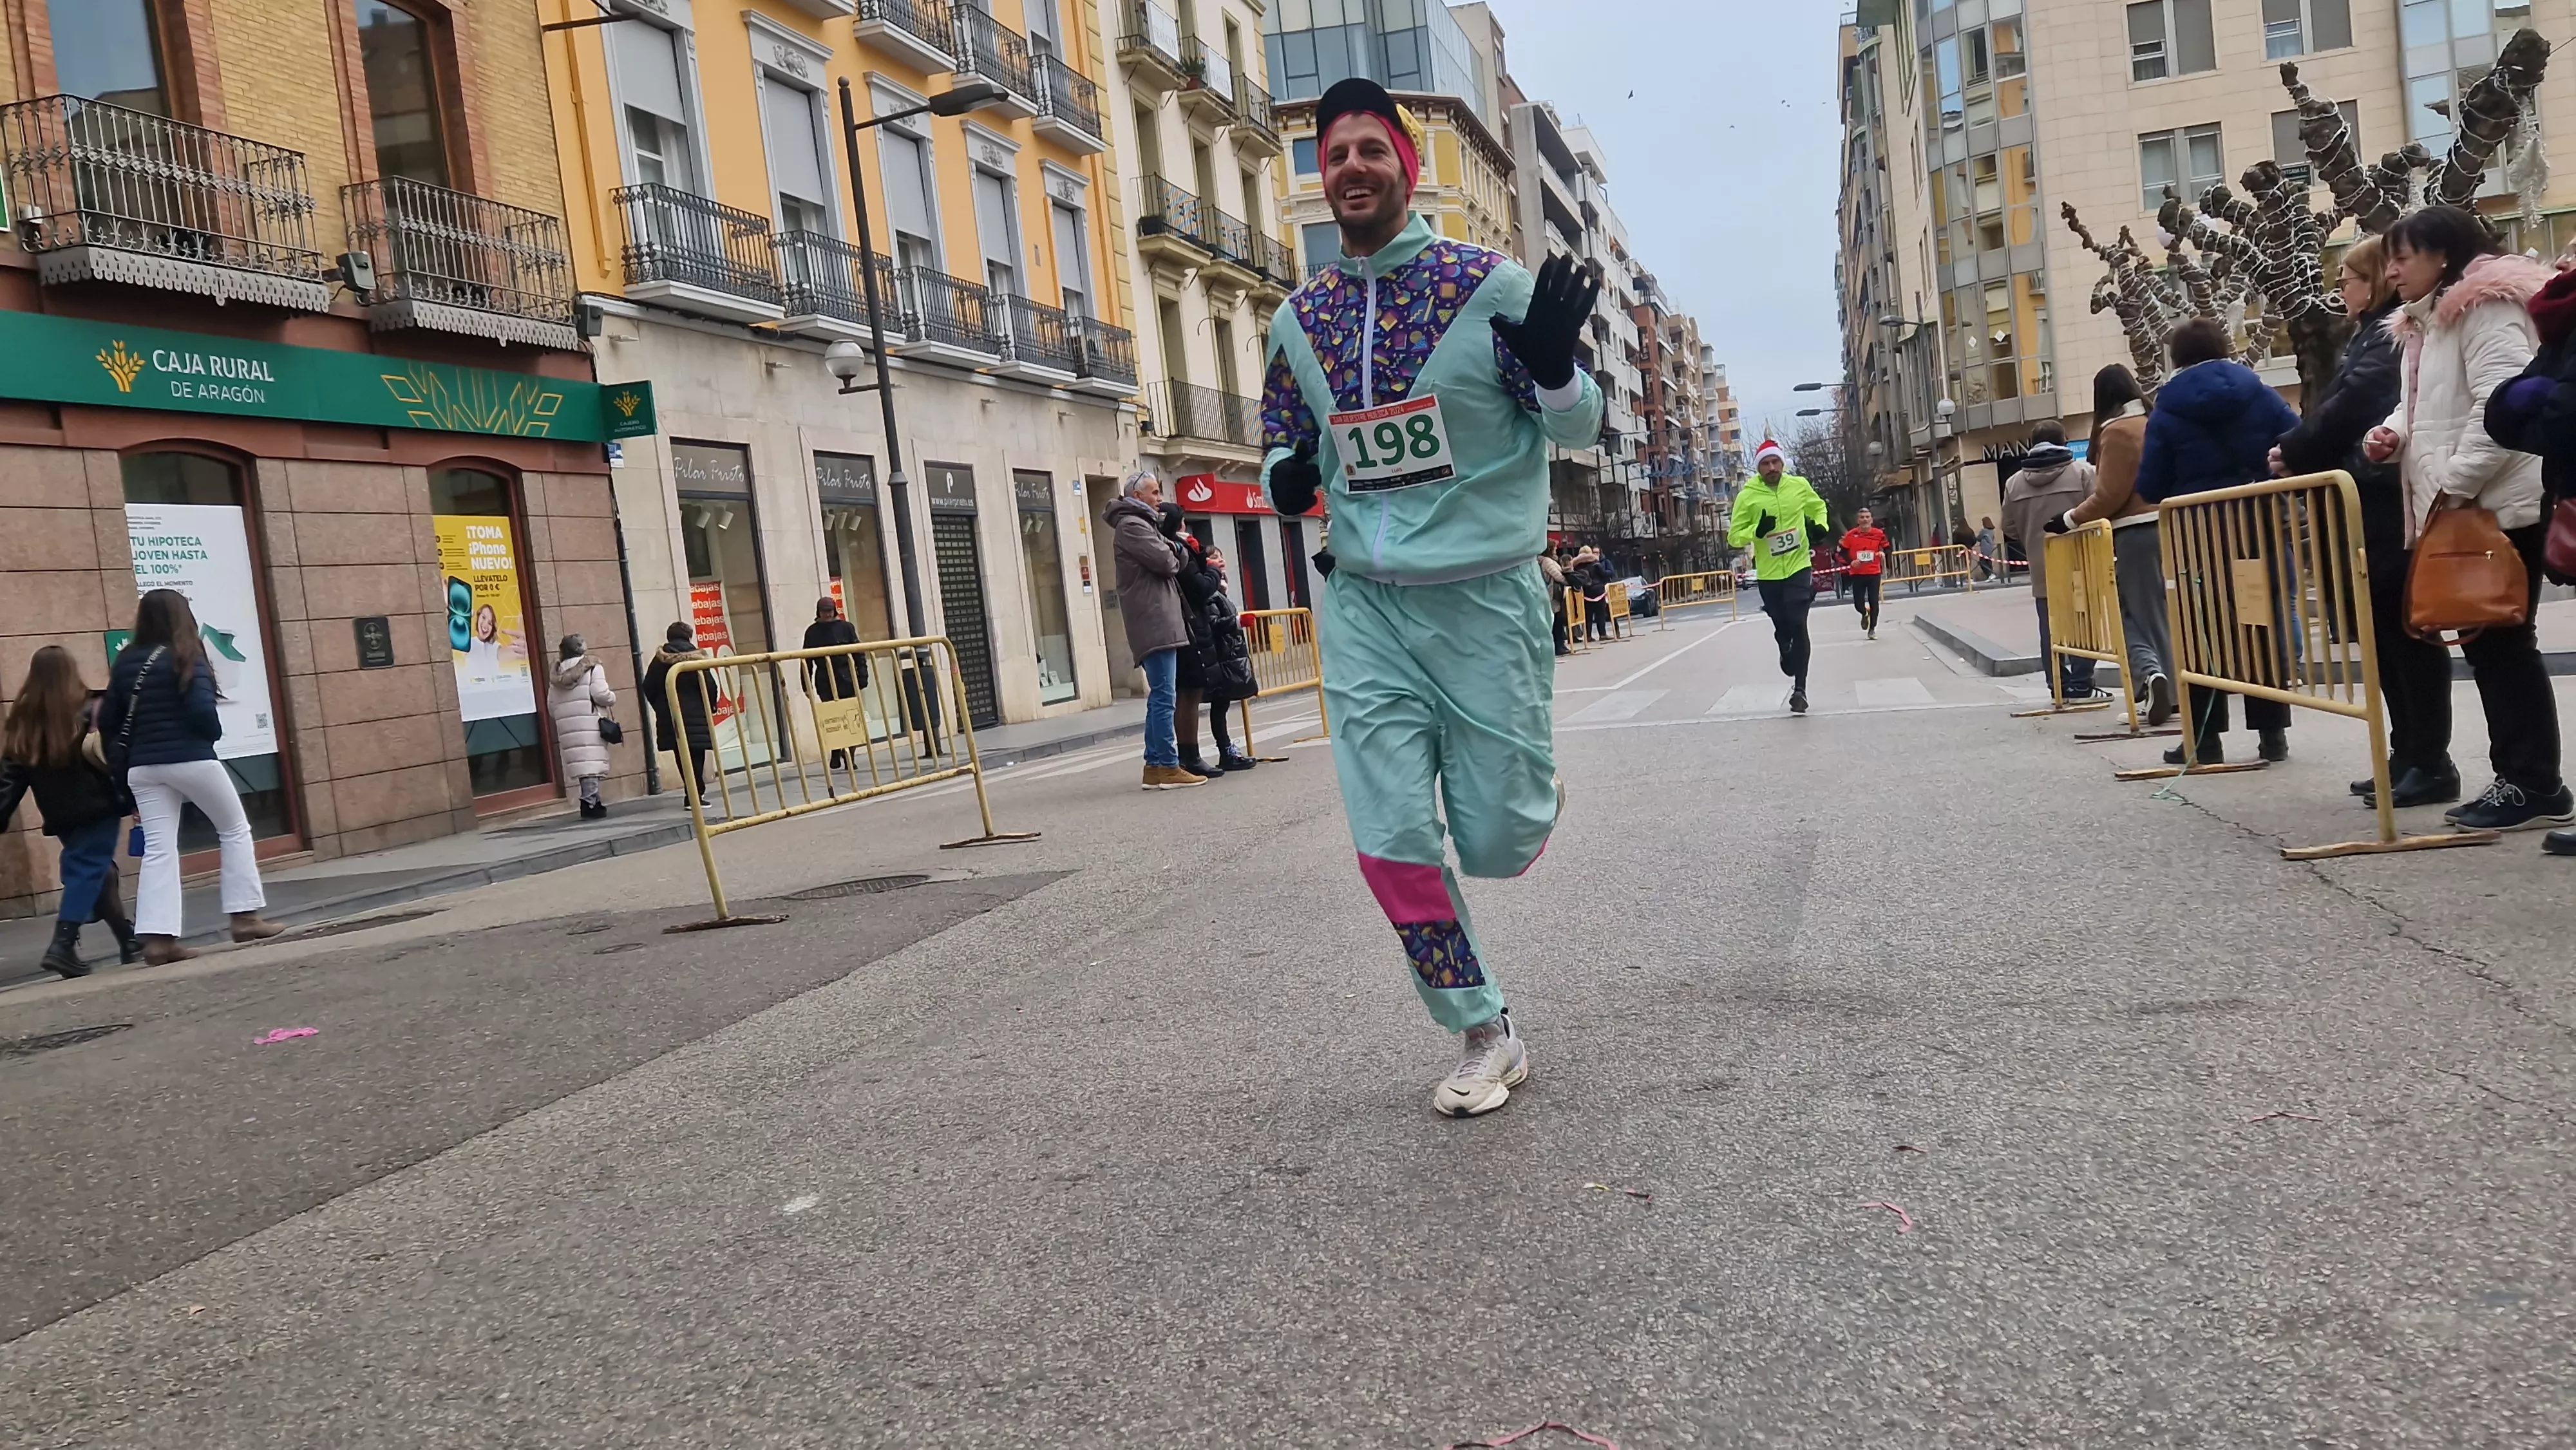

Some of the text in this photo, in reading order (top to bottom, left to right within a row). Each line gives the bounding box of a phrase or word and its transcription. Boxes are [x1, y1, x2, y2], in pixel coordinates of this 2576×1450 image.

[152, 349, 275, 382] CAJA RURAL
[171, 381, 265, 403] DE ARAGÓN
[1367, 408, 1389, 419] HUESCA
[1390, 405, 1404, 415] 2024
[1347, 414, 1441, 468] 198
[1982, 438, 2030, 462] MAN
[466, 525, 503, 539] ¡TOMA
[129, 536, 202, 547] TU HIPOTECA
[1776, 532, 1794, 548] 39
[469, 541, 506, 555] iPhone
[133, 550, 208, 560] JOVEN HASTA
[134, 564, 148, 574] EL
[471, 557, 513, 570] NUEVO!
[689, 582, 720, 594] ebajas
[692, 598, 723, 610] ebajas
[694, 614, 725, 626] ebajas
[697, 631, 728, 642] ebajas
